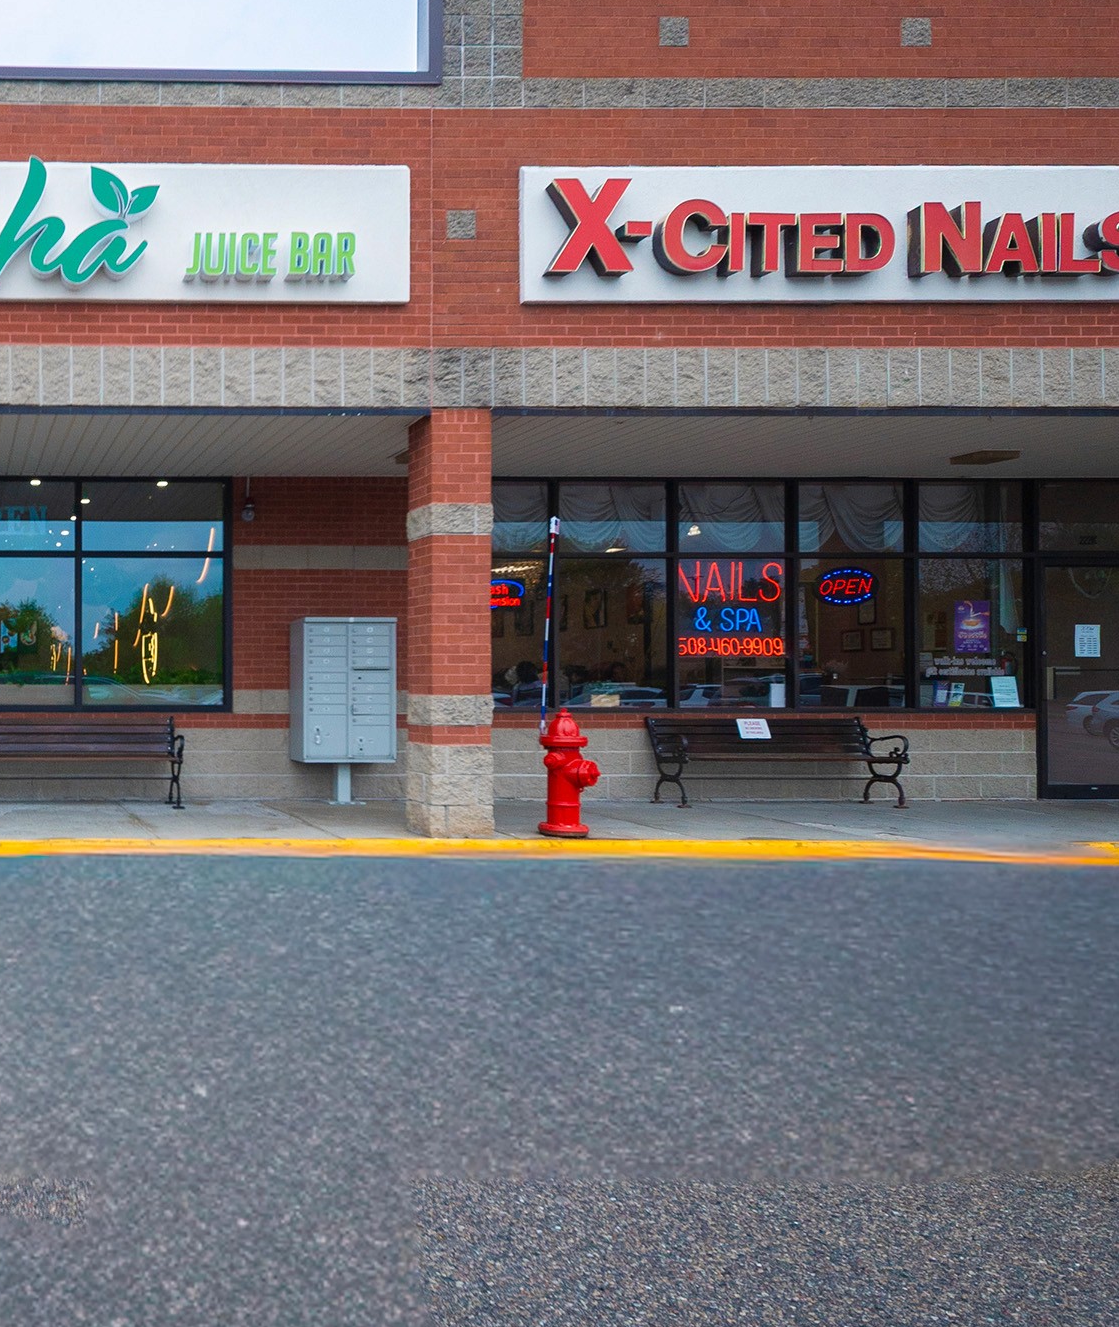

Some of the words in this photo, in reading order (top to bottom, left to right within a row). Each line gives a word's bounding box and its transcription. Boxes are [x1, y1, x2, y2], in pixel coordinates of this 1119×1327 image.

[543, 178, 896, 278] X-CITED
[184, 232, 279, 280] JUICE
[286, 232, 357, 281] BAR
[490, 584, 509, 595] ash
[678, 560, 783, 603] NAILS
[819, 578, 873, 595] OPEN
[694, 606, 713, 632] &
[720, 607, 763, 632] SPA
[678, 637, 785, 656] 508-460-9909
